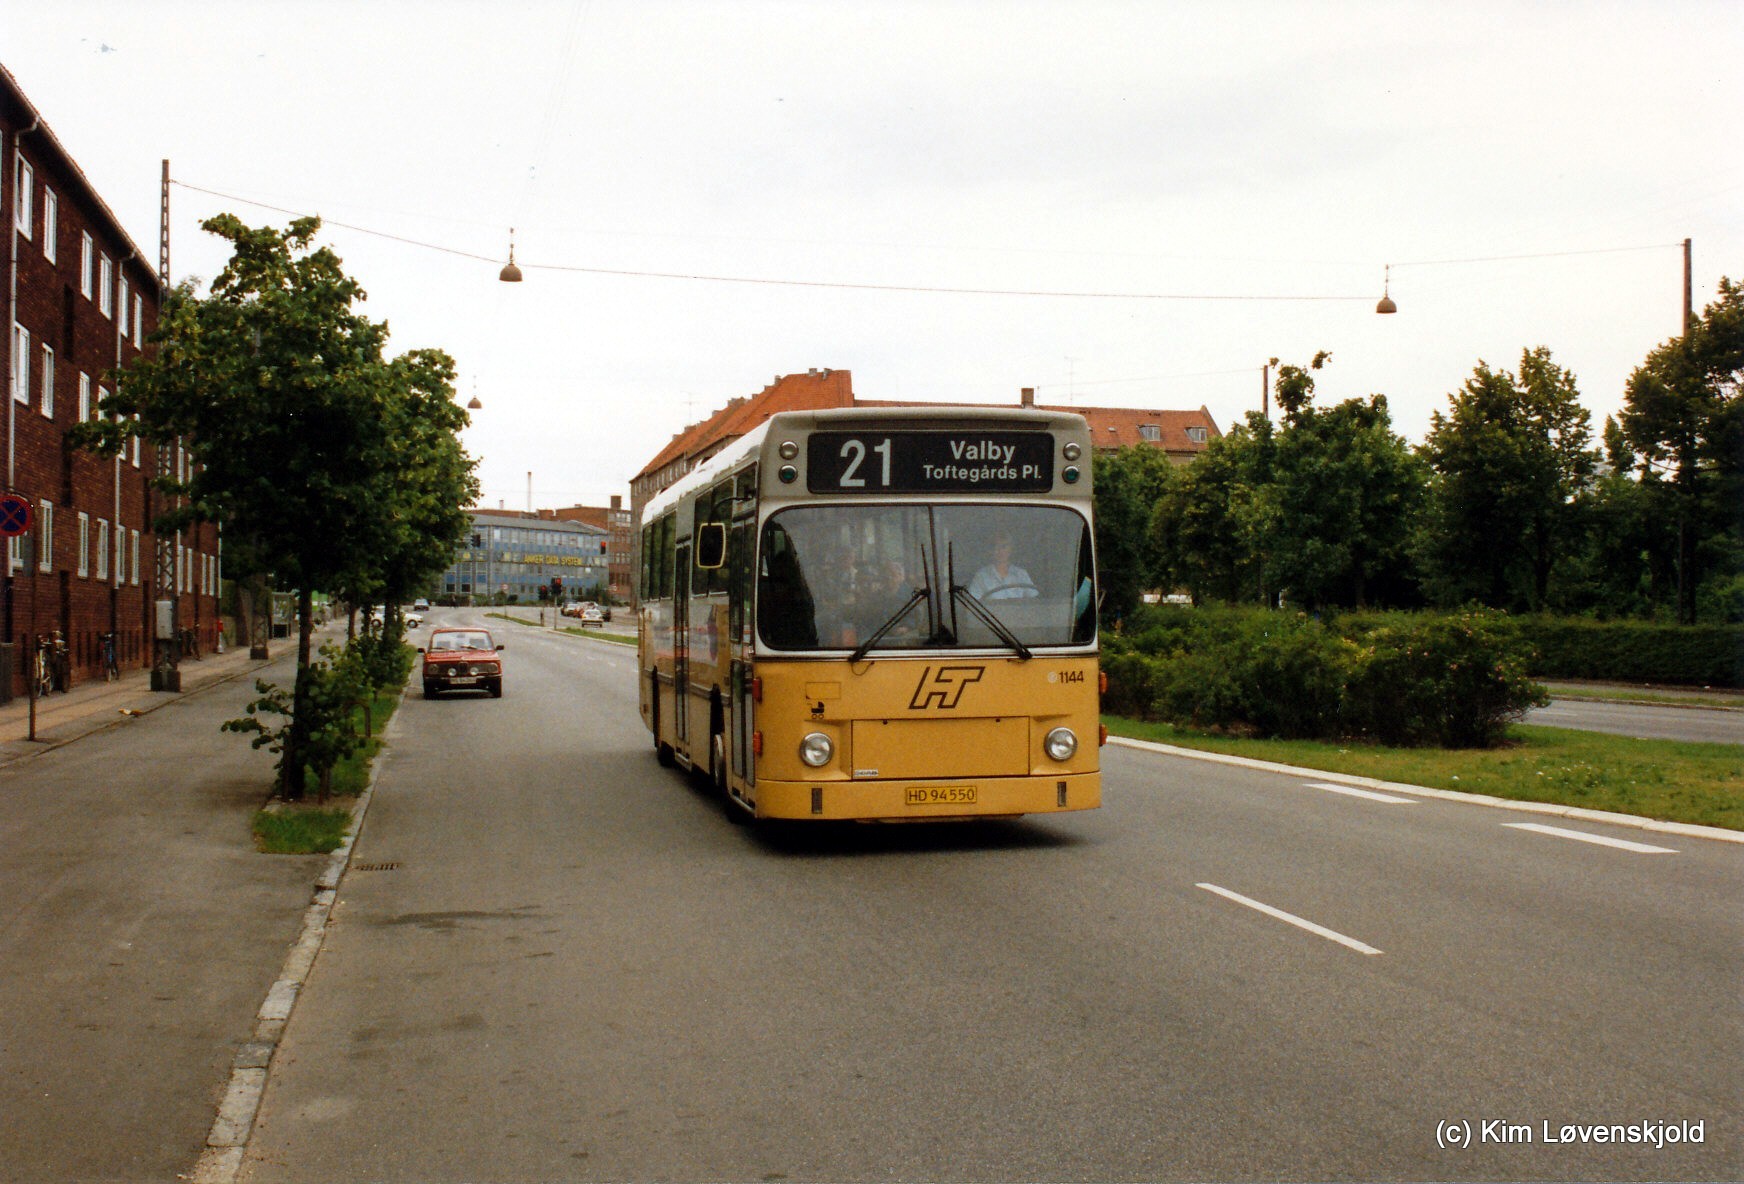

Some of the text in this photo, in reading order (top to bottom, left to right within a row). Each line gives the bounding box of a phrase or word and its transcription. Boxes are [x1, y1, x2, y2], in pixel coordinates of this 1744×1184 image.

[950, 440, 1016, 463] Valby
[839, 438, 892, 487] 21
[923, 464, 1042, 482] Toftegårds Pl.
[1059, 671, 1084, 683] 1144
[908, 790, 927, 801] HD
